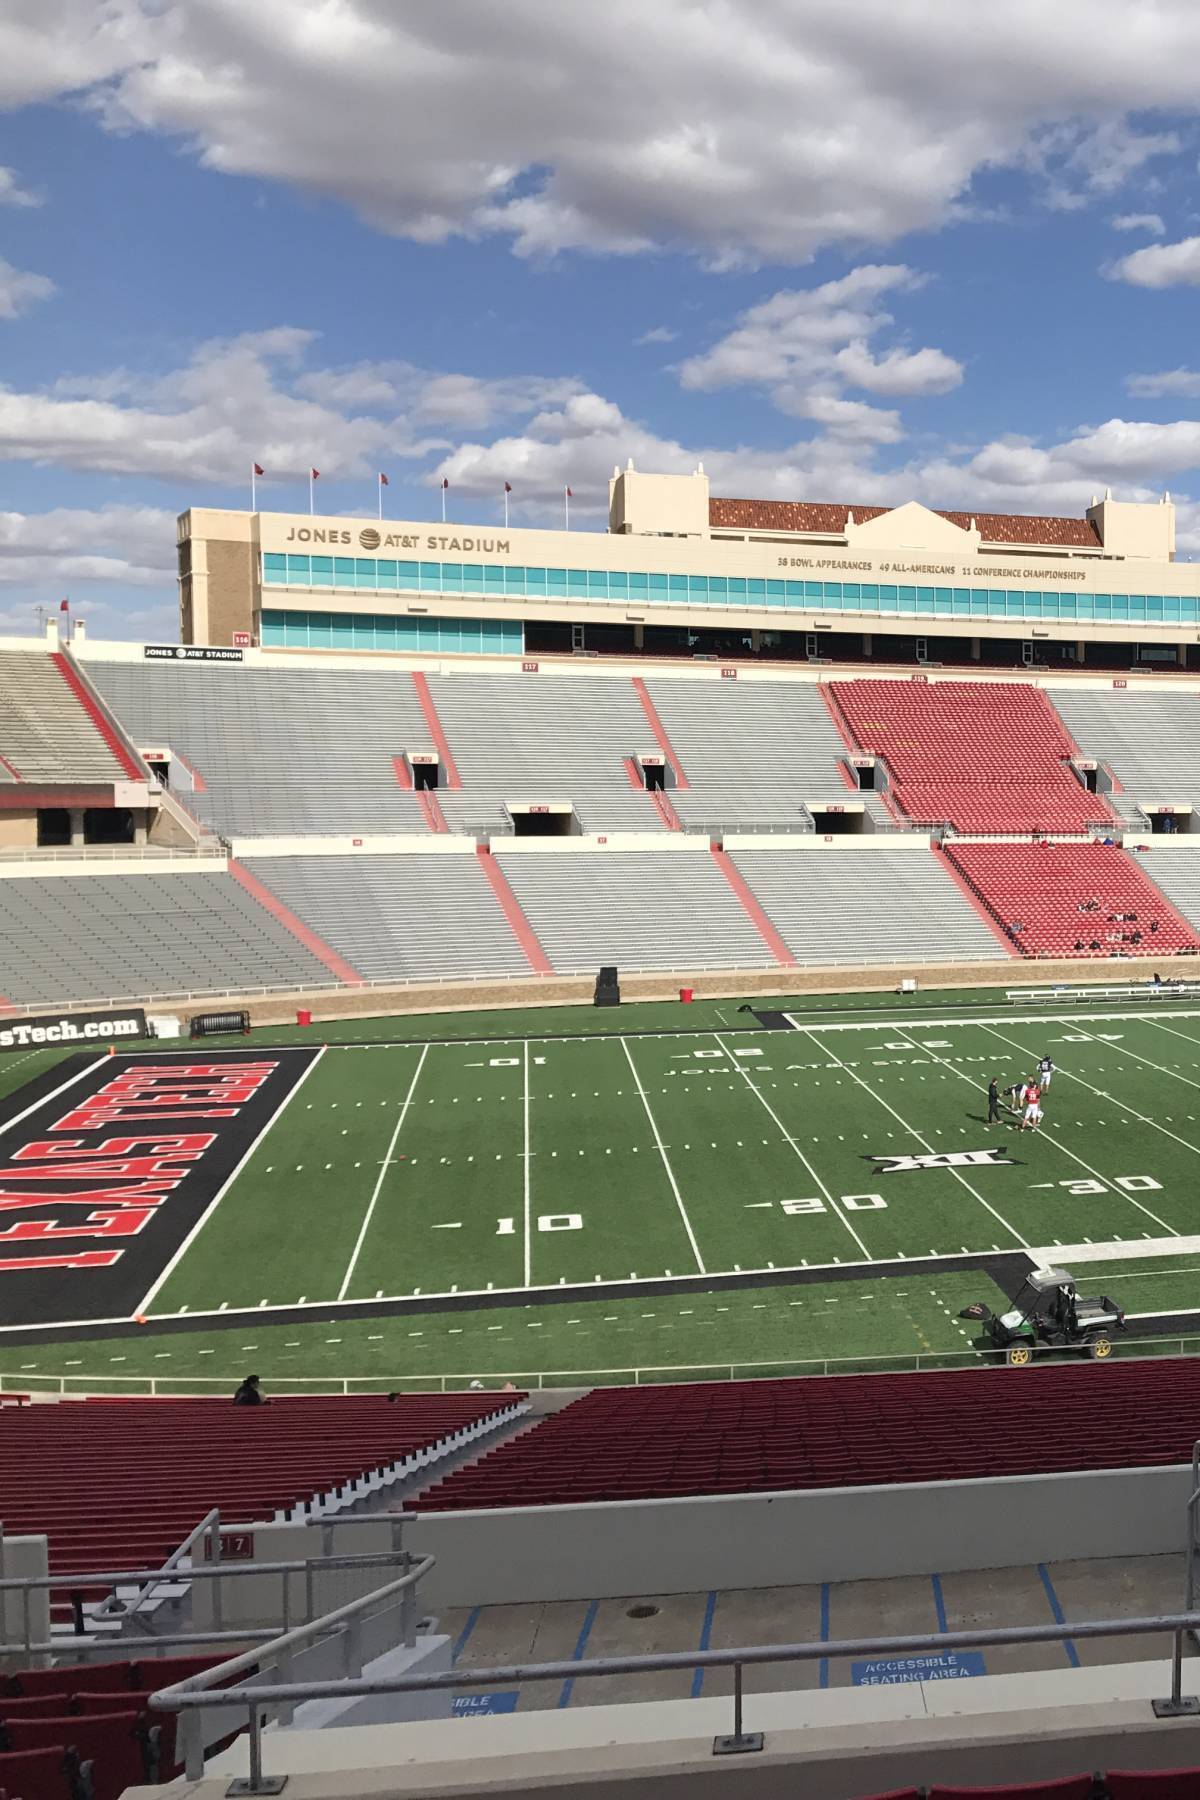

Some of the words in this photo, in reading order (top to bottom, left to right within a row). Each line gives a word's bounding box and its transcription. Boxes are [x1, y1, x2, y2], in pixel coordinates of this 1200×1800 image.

[286, 527, 352, 545] JONES
[384, 533, 420, 549] AT&T
[427, 536, 511, 553] STADIUM
[777, 557, 788, 567] 38
[790, 558, 814, 568] BOWL
[816, 559, 872, 571] APPEARANCES
[891, 563, 955, 575] ALL-AMERICANS
[962, 567, 971, 576] 11
[973, 567, 1021, 578] CONFERENCE
[1023, 569, 1086, 581] CHAMPIONSHIPS
[145, 649, 173, 657] JONES
[186, 650, 204, 658] AT&T
[205, 651, 242, 659] STADIUM
[524, 663, 537, 671] 117
[489, 1057, 547, 1066] 10
[663, 1066, 774, 1076] JONES
[871, 1055, 1013, 1067] STADIUM
[1058, 1175, 1165, 1196] 30
[780, 1193, 888, 1215] 20
[495, 1213, 583, 1235] 10
[865, 1656, 958, 1673] ACCESSIBLE
[860, 1672, 925, 1686] SEATING
[928, 1667, 970, 1681] AREA
